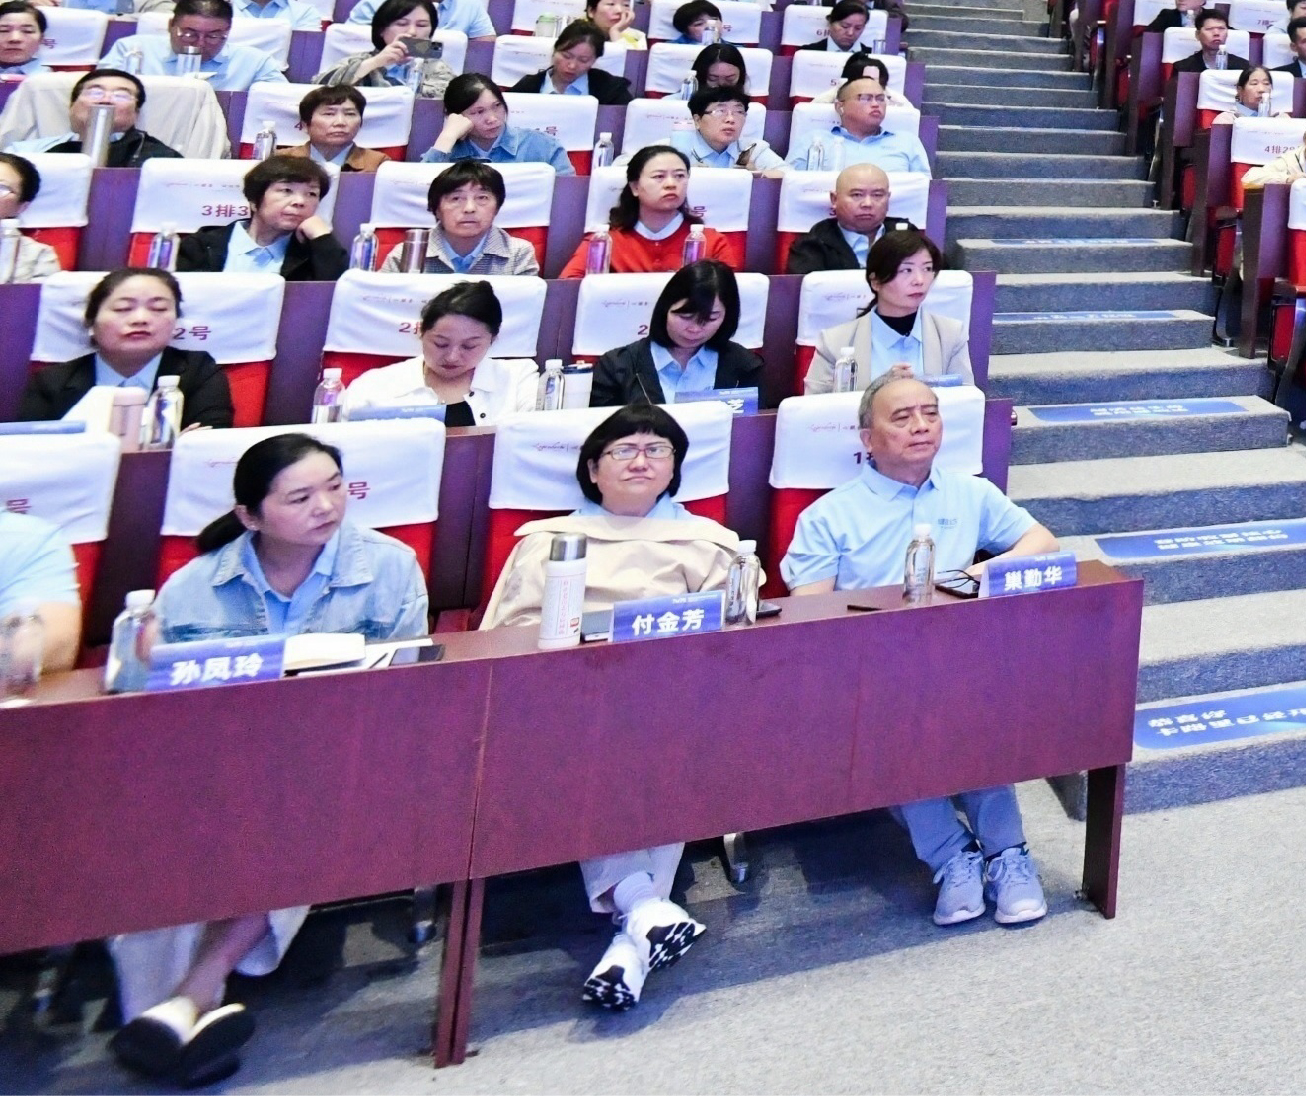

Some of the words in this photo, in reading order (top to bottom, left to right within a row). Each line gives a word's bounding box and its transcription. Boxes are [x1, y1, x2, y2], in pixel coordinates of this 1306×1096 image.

[202, 205, 249, 217] 3排3
[1004, 565, 1062, 591] 巢勤华
[632, 608, 705, 636] 付金芳
[170, 656, 263, 687] 孙凤玲
